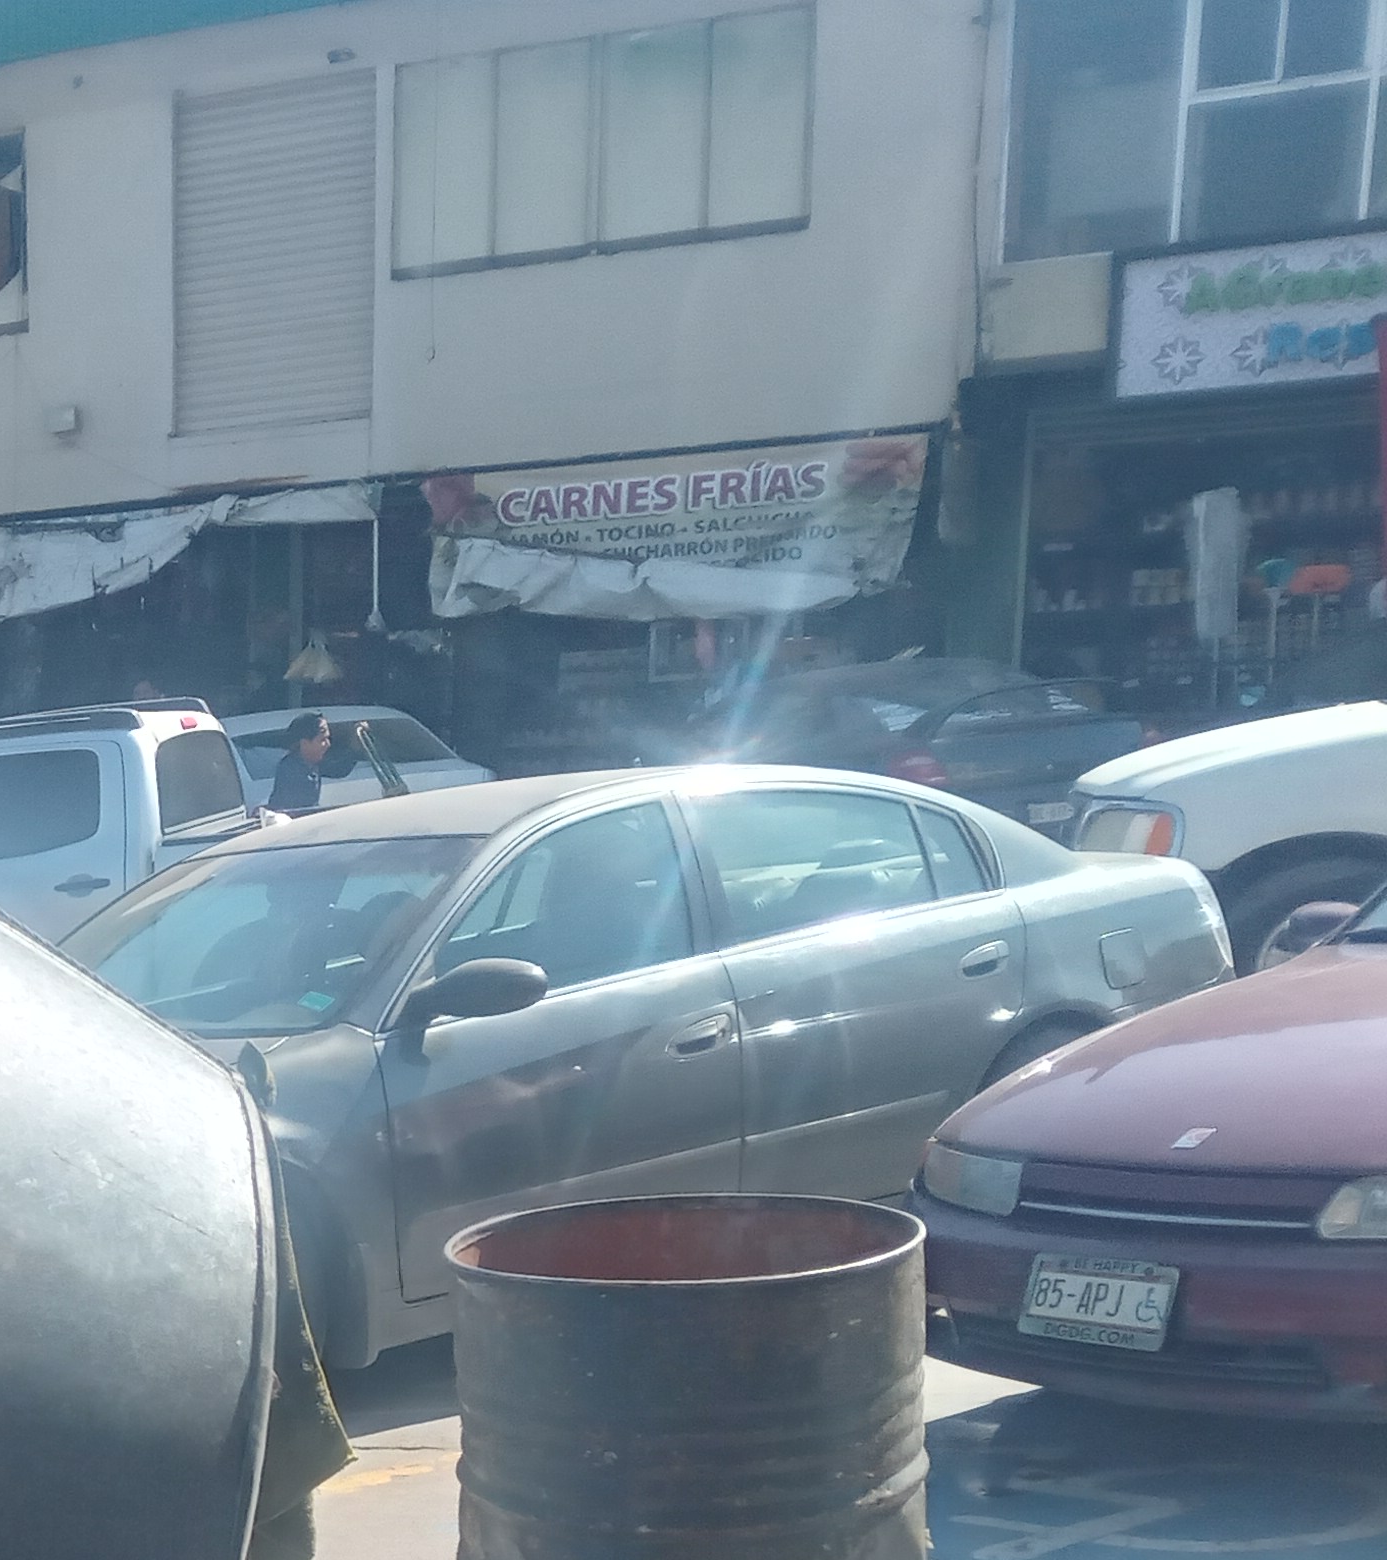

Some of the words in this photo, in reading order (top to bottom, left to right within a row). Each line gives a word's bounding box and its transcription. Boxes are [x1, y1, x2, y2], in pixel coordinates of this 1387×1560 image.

[498, 474, 677, 526] CARNES
[687, 460, 828, 513] FRÍAS
[1034, 1277, 1125, 1317] 85-APJ
